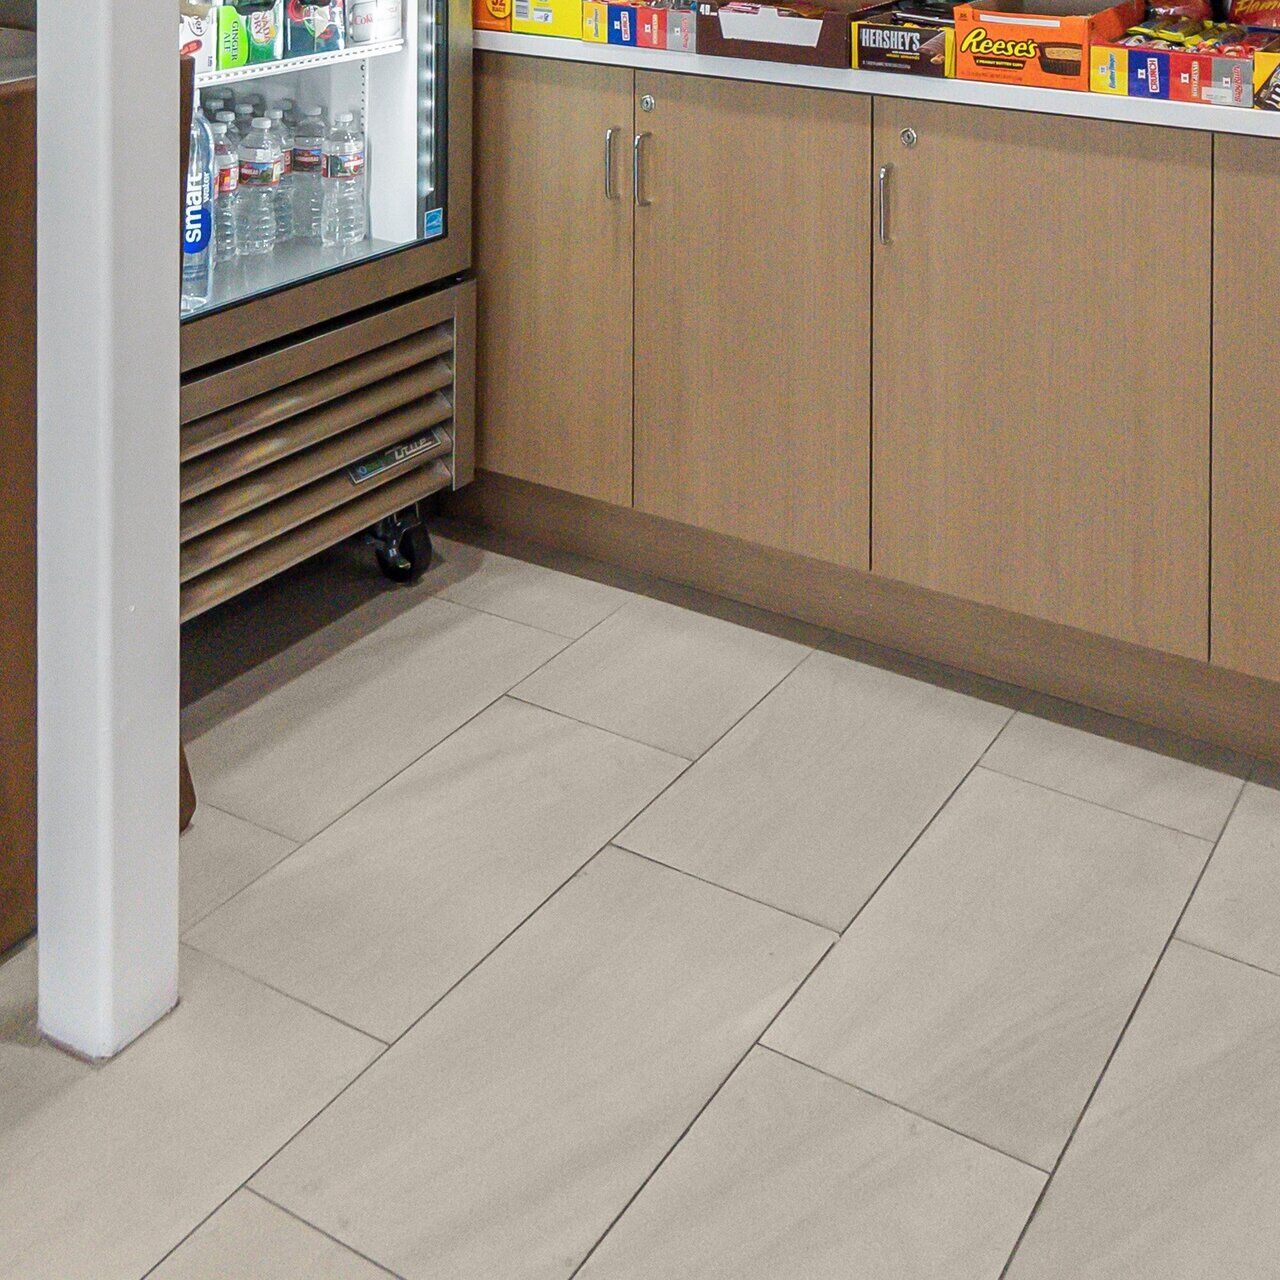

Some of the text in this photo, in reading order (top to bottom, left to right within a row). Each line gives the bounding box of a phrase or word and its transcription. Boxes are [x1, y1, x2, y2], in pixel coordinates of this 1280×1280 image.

[231, 20, 239, 61] GINGER
[862, 28, 919, 51] HERSHEY'S
[960, 28, 1038, 57] Reese's
[1150, 59, 1158, 91] CRUNCH
[185, 171, 202, 243] smart
